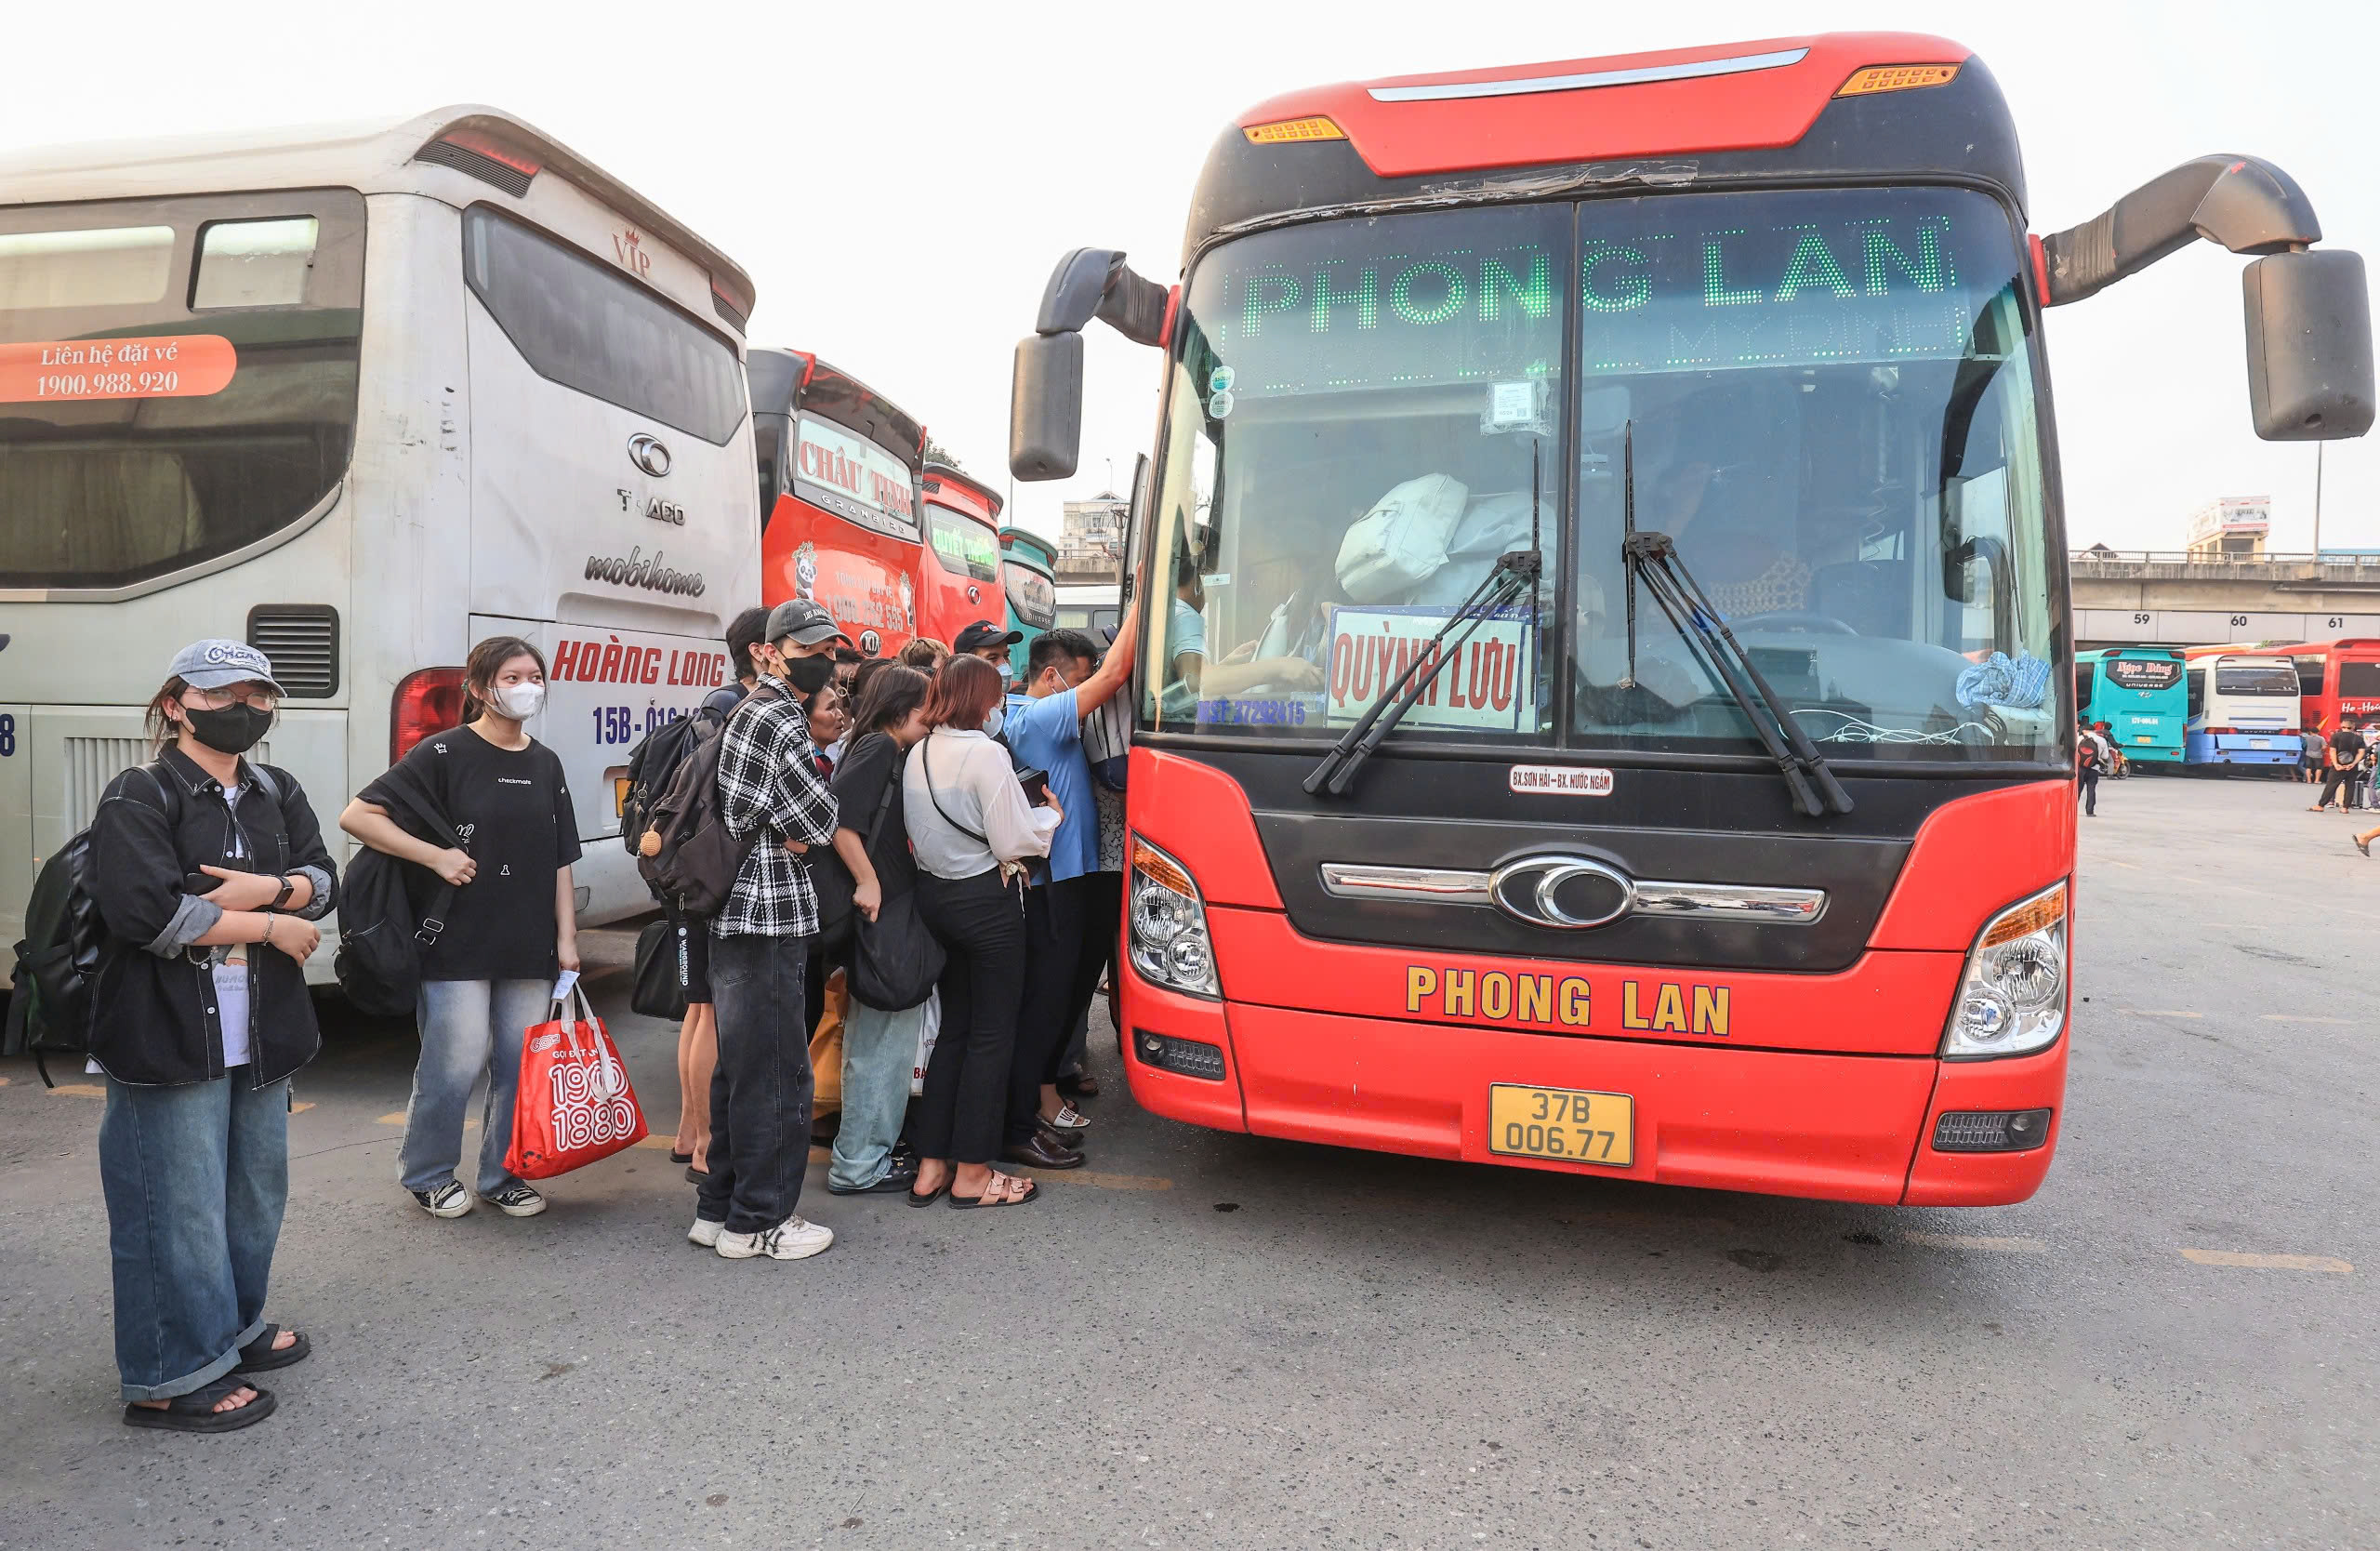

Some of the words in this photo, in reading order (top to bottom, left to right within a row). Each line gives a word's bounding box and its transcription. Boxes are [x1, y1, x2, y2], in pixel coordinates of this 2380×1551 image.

[612, 232, 650, 279] VIP
[1242, 245, 1652, 337] PHONG
[1702, 224, 1945, 307] LAN
[41, 347, 85, 365] Liên
[88, 344, 113, 366] hệ
[117, 343, 148, 366] đặt
[153, 341, 178, 361] vé
[36, 371, 178, 396] 1900.988.920
[800, 441, 863, 495] CHÂU
[616, 488, 685, 526] TACO
[821, 495, 906, 534] GRANBIRD
[585, 545, 705, 598] mobihome
[885, 603, 904, 632] 555
[2134, 614, 2150, 625] 59
[2230, 616, 2247, 627] 60
[2328, 617, 2344, 629] 61
[549, 634, 662, 684] HOÀNG
[667, 649, 726, 687] LONG
[865, 636, 880, 652] KIA
[1330, 620, 1442, 709] QUỲNH
[1448, 636, 1516, 712] LƯU
[681, 939, 689, 986] WARGROUND
[1406, 965, 1592, 1027] PHONG
[1622, 980, 1731, 1037] LAN
[569, 1048, 587, 1058] ĐT
[550, 1096, 637, 1152] 1880
[1531, 1093, 1591, 1124] 37B
[1505, 1122, 1615, 1160] 006.77
